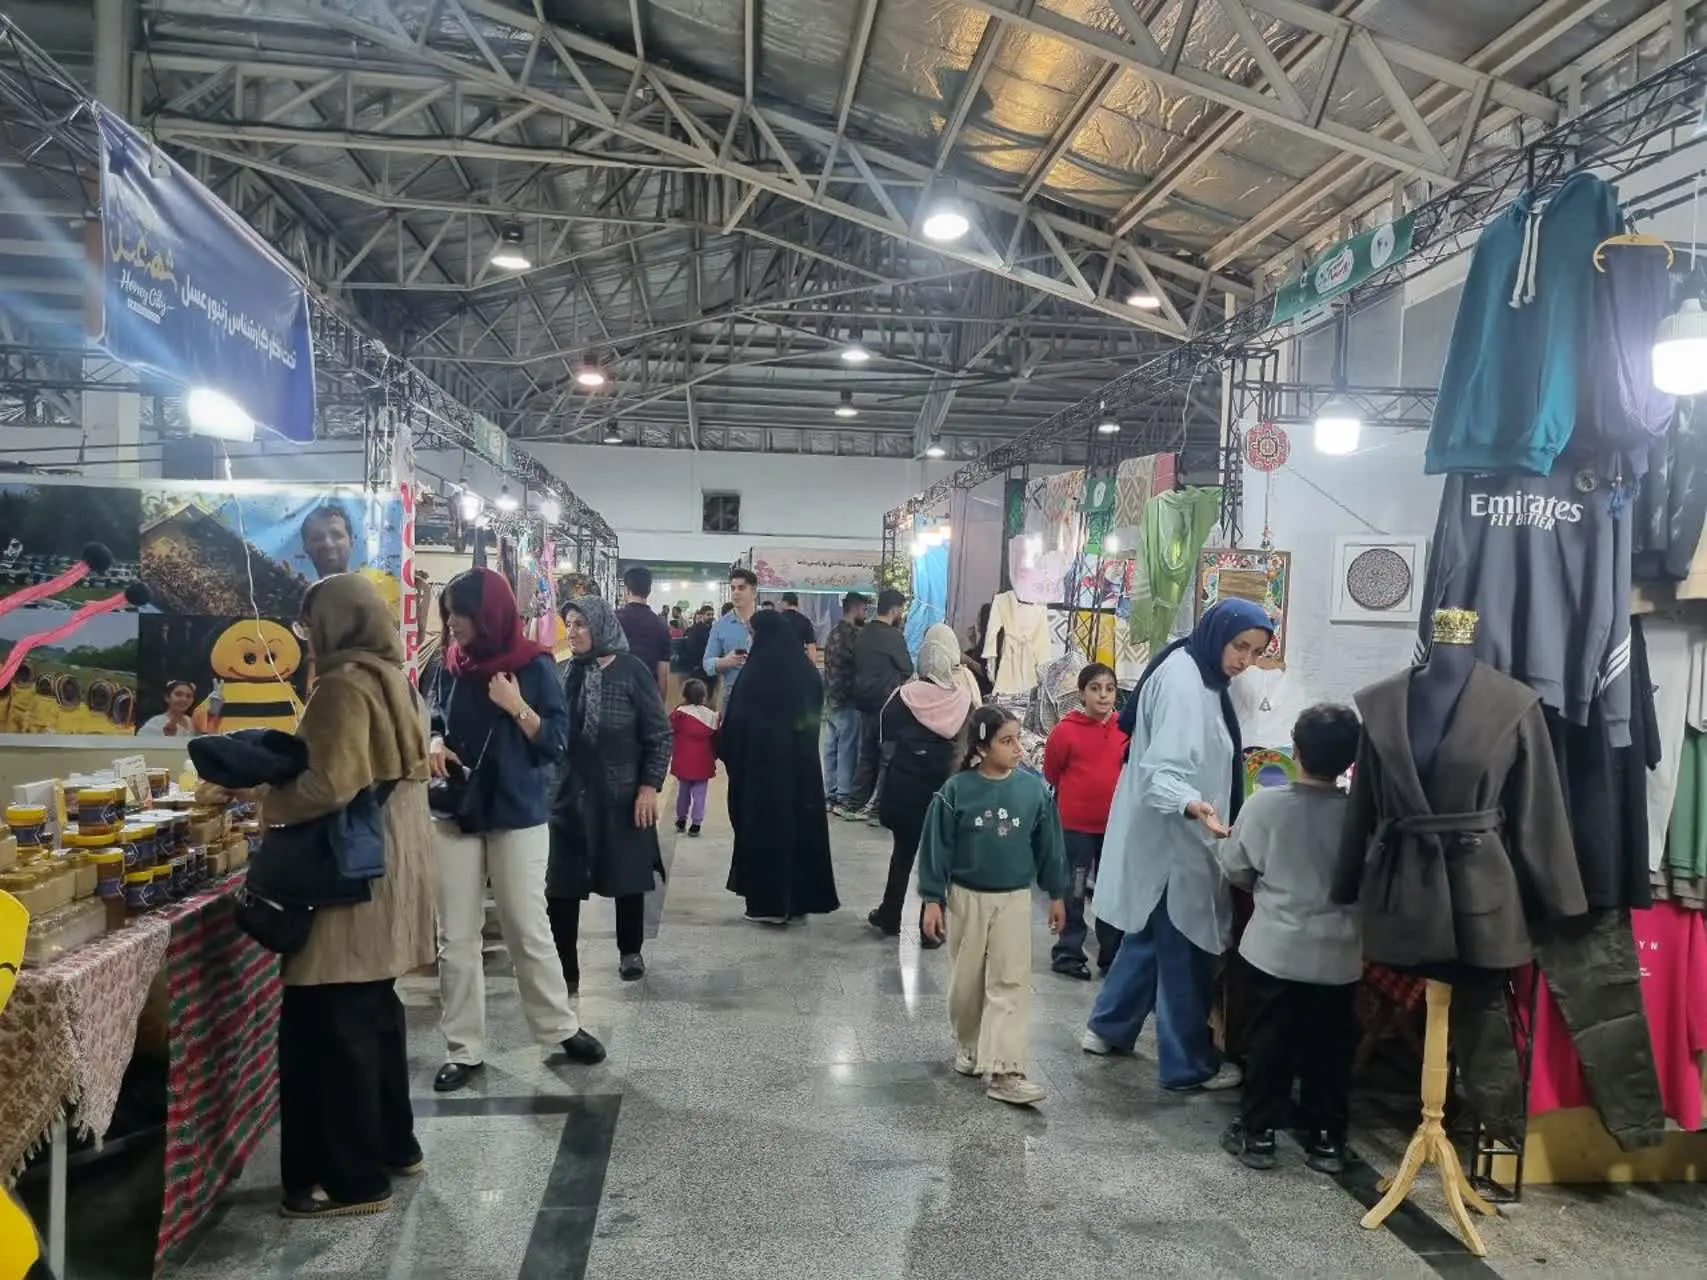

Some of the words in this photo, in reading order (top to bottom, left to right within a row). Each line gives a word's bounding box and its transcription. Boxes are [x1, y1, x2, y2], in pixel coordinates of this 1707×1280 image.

[119, 268, 149, 306] Honey
[148, 287, 177, 318] City
[181, 274, 207, 309] عسل
[1469, 489, 1584, 523] Emirates
[1490, 513, 1514, 527] FLY
